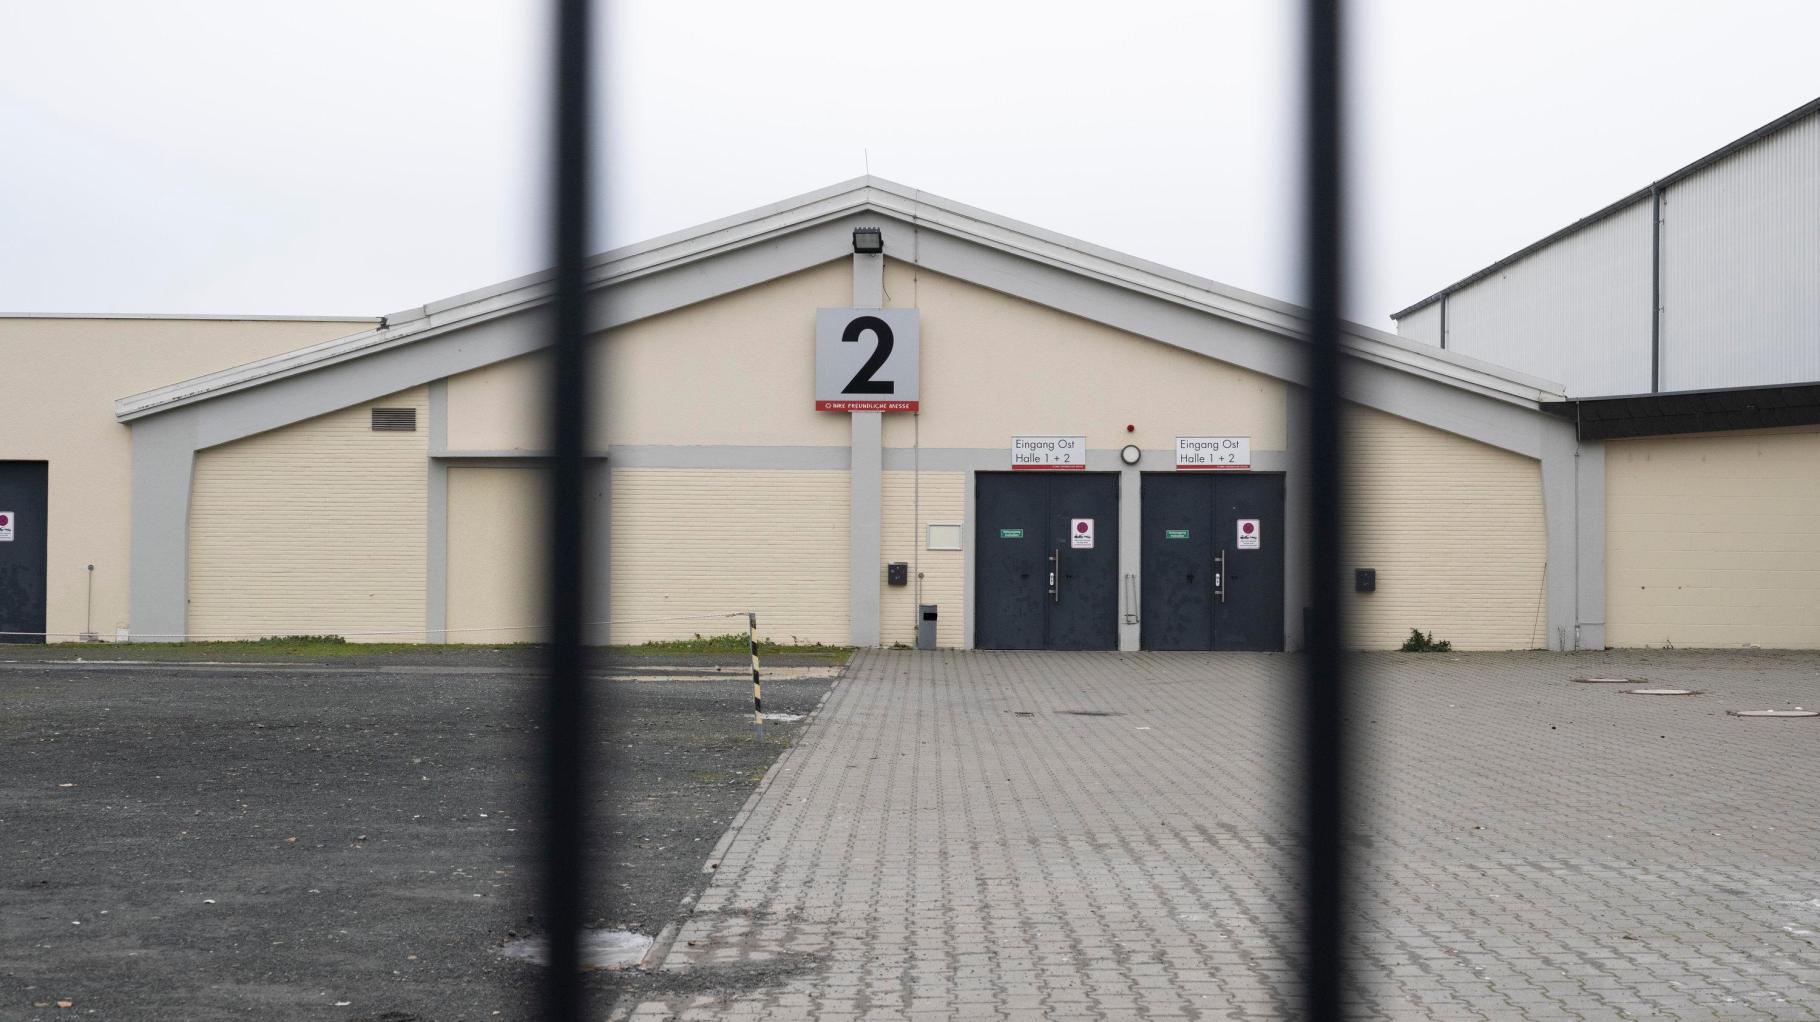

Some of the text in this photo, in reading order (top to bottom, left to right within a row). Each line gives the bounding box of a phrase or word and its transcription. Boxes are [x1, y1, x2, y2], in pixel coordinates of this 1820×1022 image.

[841, 316, 894, 394] 2
[1015, 439, 1075, 451] Eingang Ost
[1180, 439, 1239, 451] Eingang Ost
[1015, 453, 1041, 463] Halle
[1045, 453, 1049, 463] 1
[1063, 453, 1071, 463] 2
[1180, 453, 1205, 463] Halle
[1209, 453, 1213, 463] 1
[1228, 453, 1235, 463] 2
